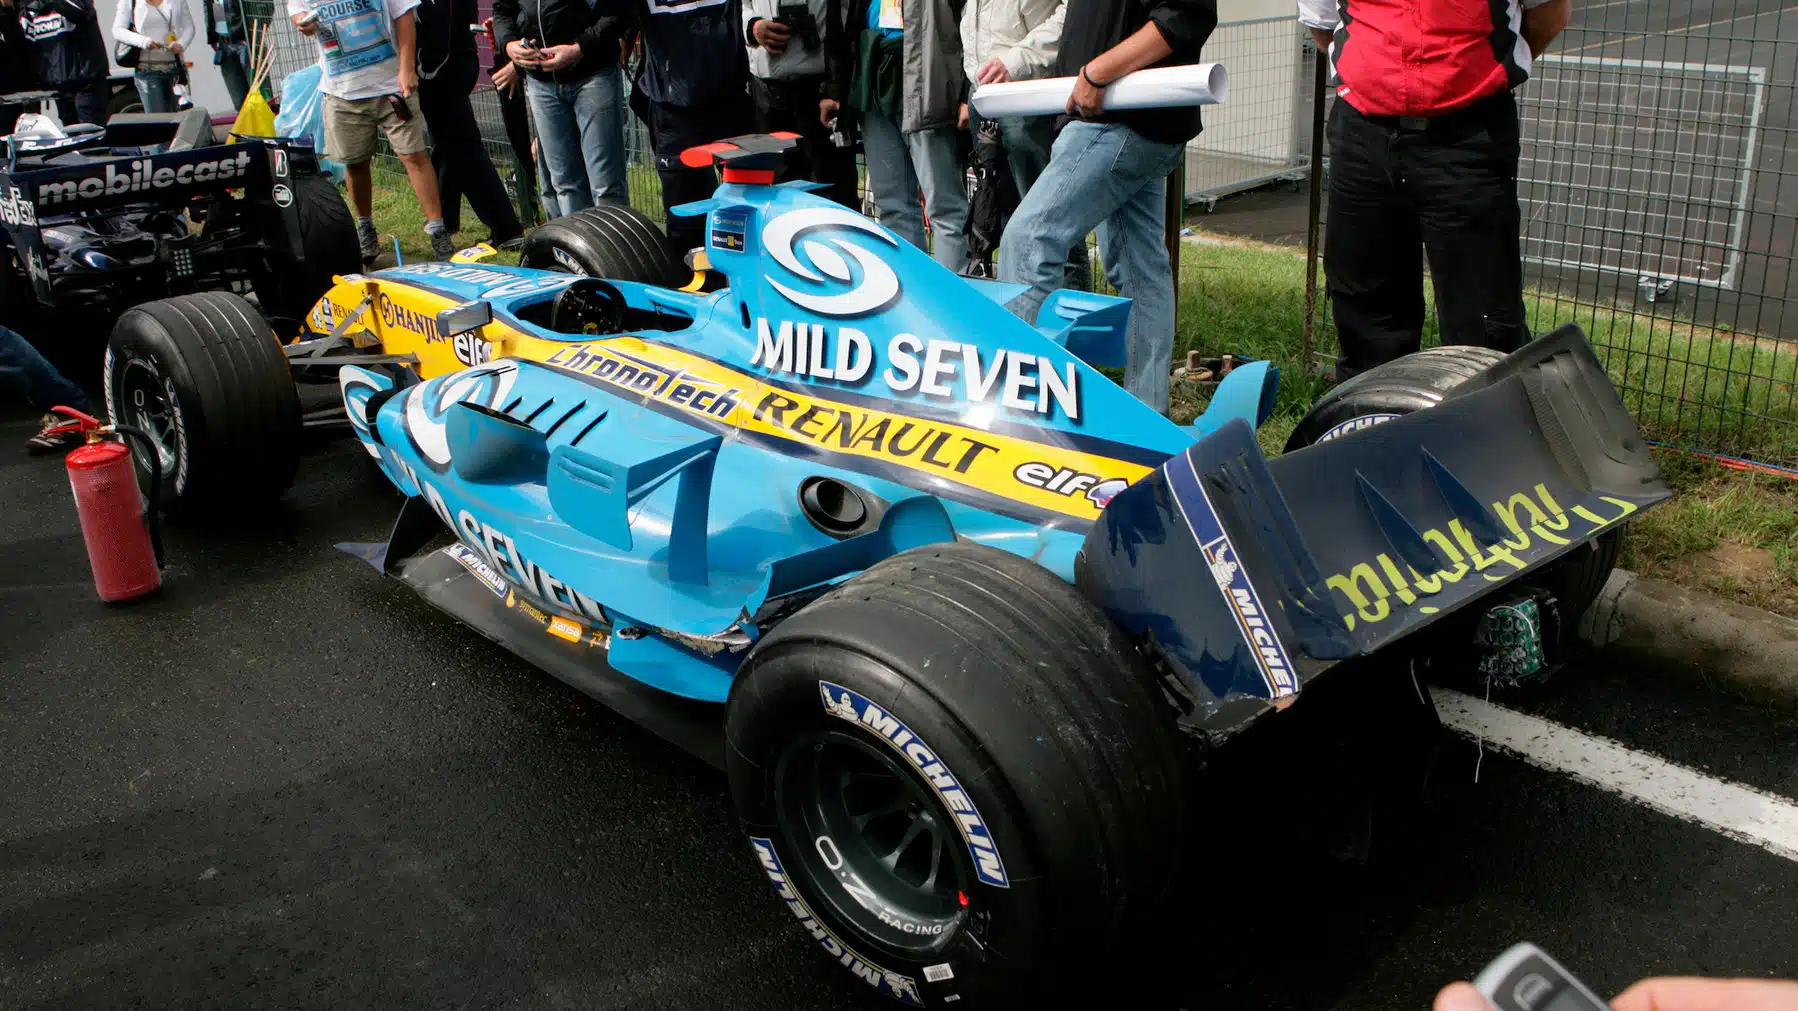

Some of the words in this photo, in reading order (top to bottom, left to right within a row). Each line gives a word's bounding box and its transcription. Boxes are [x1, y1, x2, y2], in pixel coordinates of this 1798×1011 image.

[319, 0, 372, 19] COURSE
[39, 151, 251, 206] mobilecast
[393, 304, 446, 344] HANJI
[751, 317, 873, 383] MILD
[883, 334, 1079, 420] SEVEN
[752, 391, 1000, 475] RENAULT
[1013, 461, 1101, 498] elf
[458, 509, 612, 624] SEVEN
[462, 551, 507, 593] MICHELIN
[552, 619, 581, 638] xansa
[861, 703, 1005, 884] MICHELIN
[751, 840, 881, 988] MICHELIN
[878, 910, 943, 935] RACING
